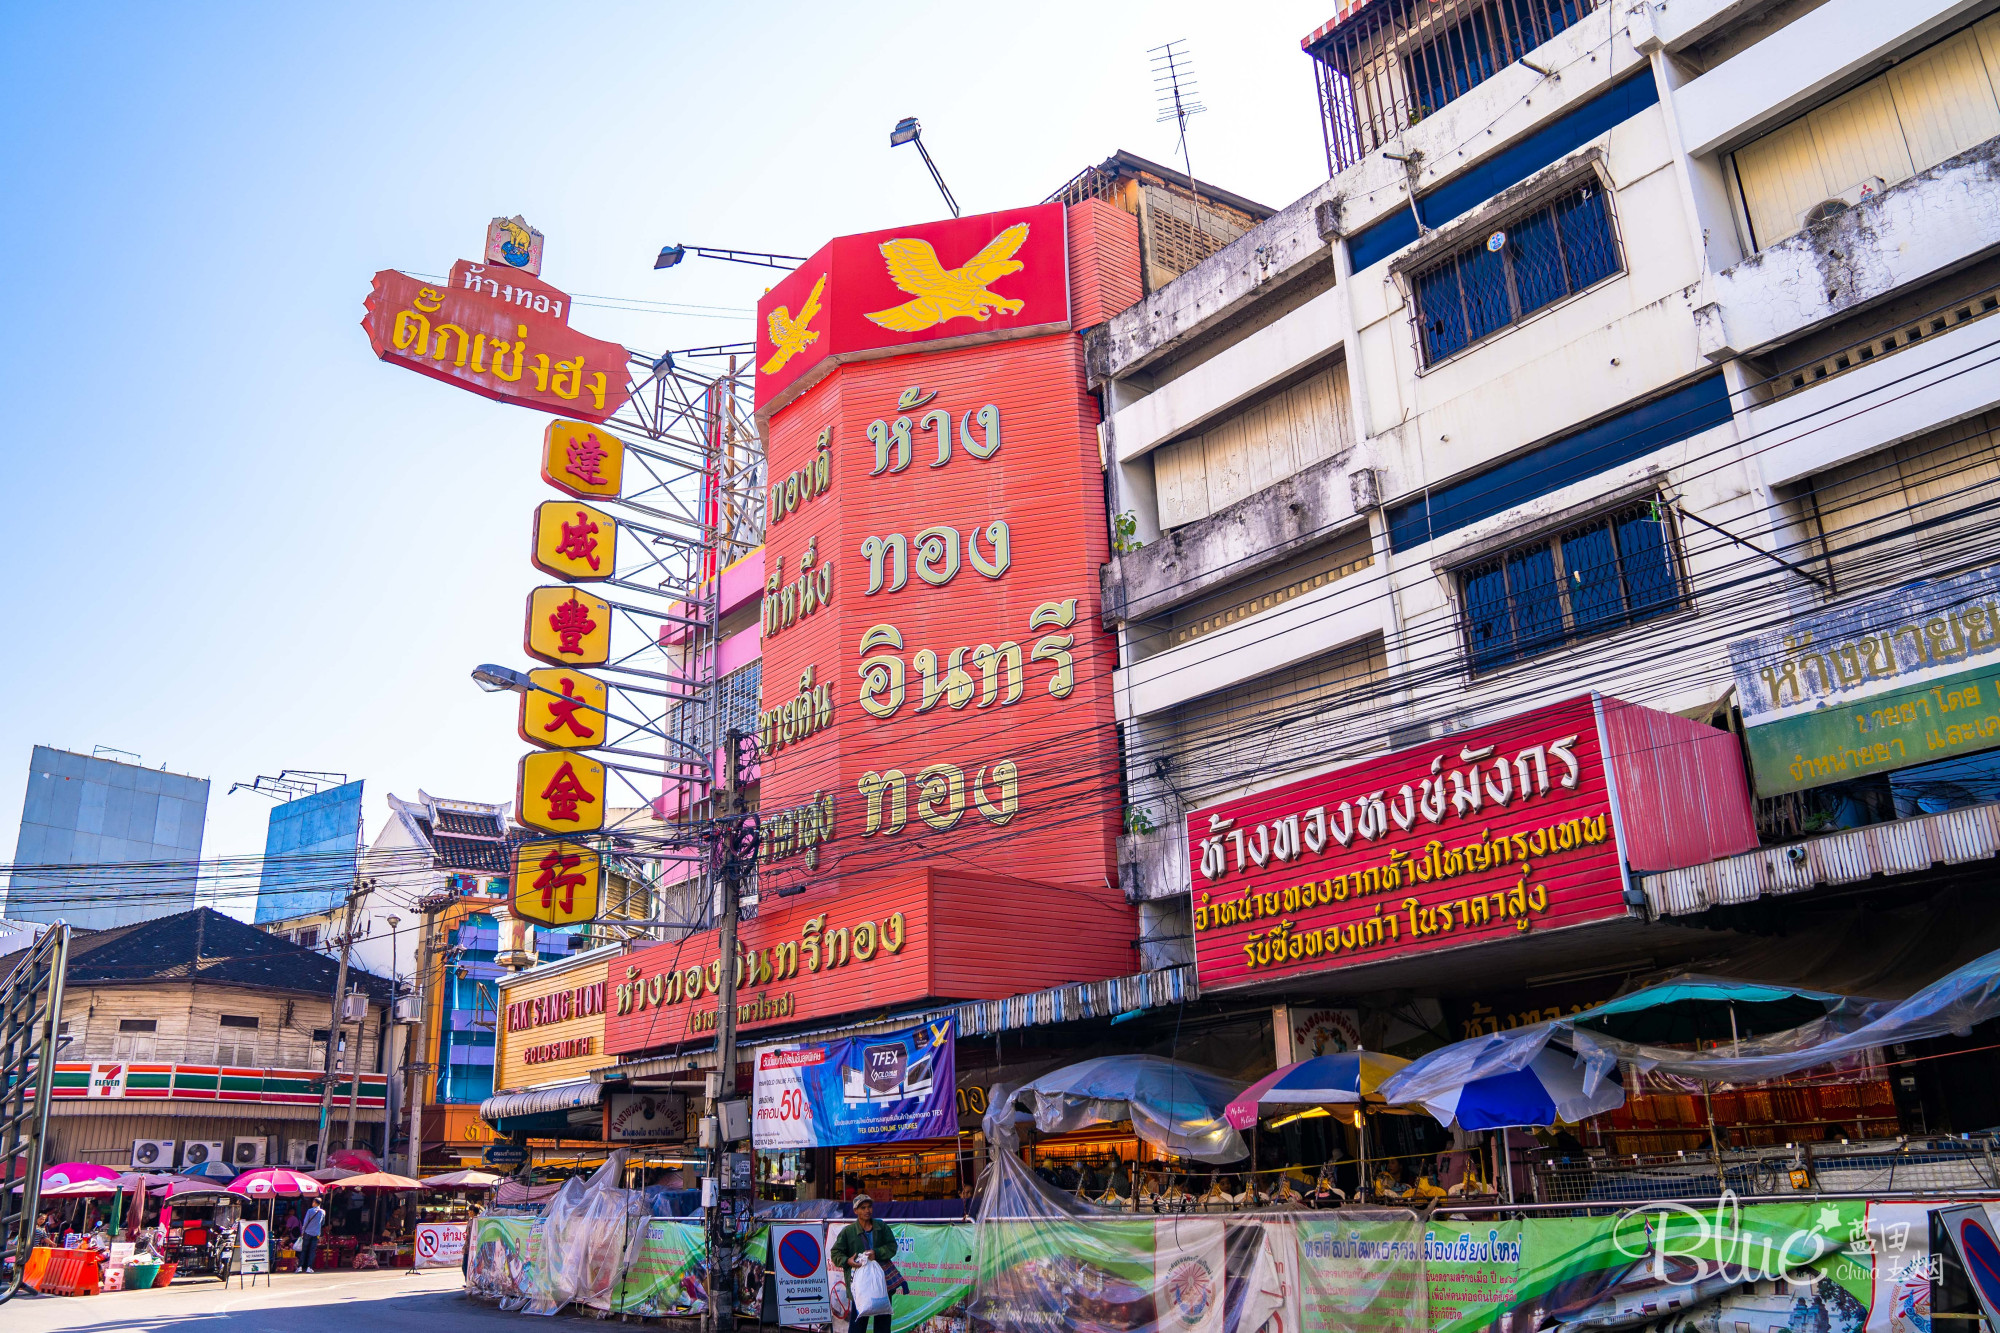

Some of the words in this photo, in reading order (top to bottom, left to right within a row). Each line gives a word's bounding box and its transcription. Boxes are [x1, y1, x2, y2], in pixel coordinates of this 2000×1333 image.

[464, 264, 563, 319] ห้างทอง
[392, 286, 607, 410] ตั๊กเซ่งฮง
[866, 386, 1002, 476] ห้าง
[771, 425, 834, 525] ทองดี
[765, 535, 834, 638] ที่หนึ่ง
[860, 519, 1011, 596] ทอง
[858, 598, 1078, 719] อินทรี
[857, 758, 1019, 838] ทอง
[1199, 735, 1579, 880] ห้างทองหงษ์มังกร
[1402, 863, 1548, 933] ในราคาสูง
[506, 1000, 531, 1032] TAK
[533, 990, 571, 1026] SANG
[575, 981, 605, 1018] HON
[98, 1065, 121, 1095] 7
[524, 1037, 590, 1064] GOLDSMITH
[872, 1050, 898, 1066] TFEX
[780, 1088, 802, 1121] 50
[804, 1102, 813, 1119] %
[867, 1126, 879, 1134] GOLD
[796, 1307, 810, 1315] 108
